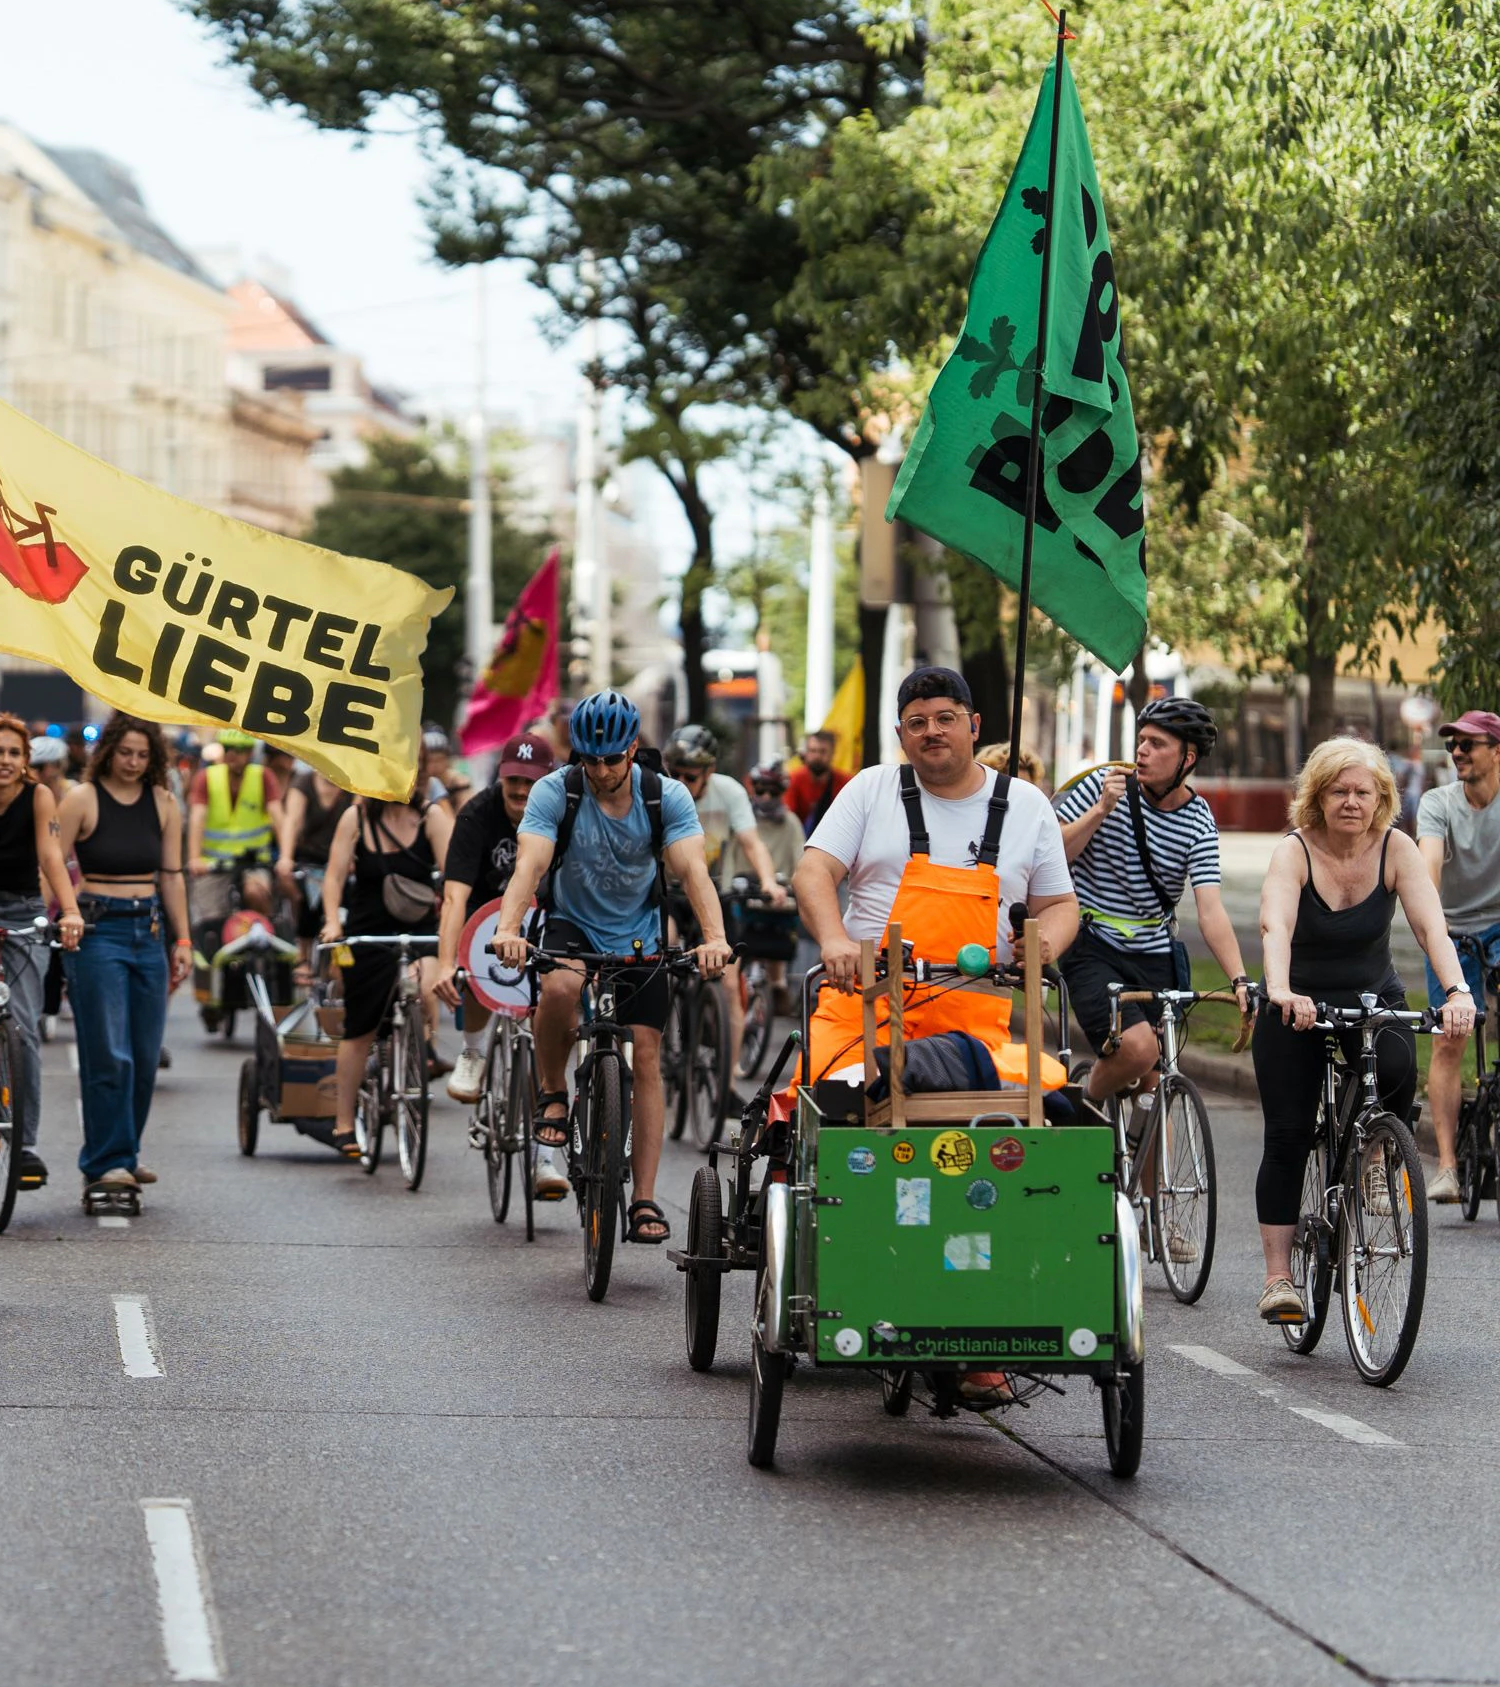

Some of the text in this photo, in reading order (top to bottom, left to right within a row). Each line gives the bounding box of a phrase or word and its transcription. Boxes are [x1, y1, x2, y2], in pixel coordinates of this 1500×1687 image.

[93, 598, 387, 754] LIEBE
[113, 545, 390, 681] GÜRTEL
[915, 1337, 1059, 1353] christiania bikes
